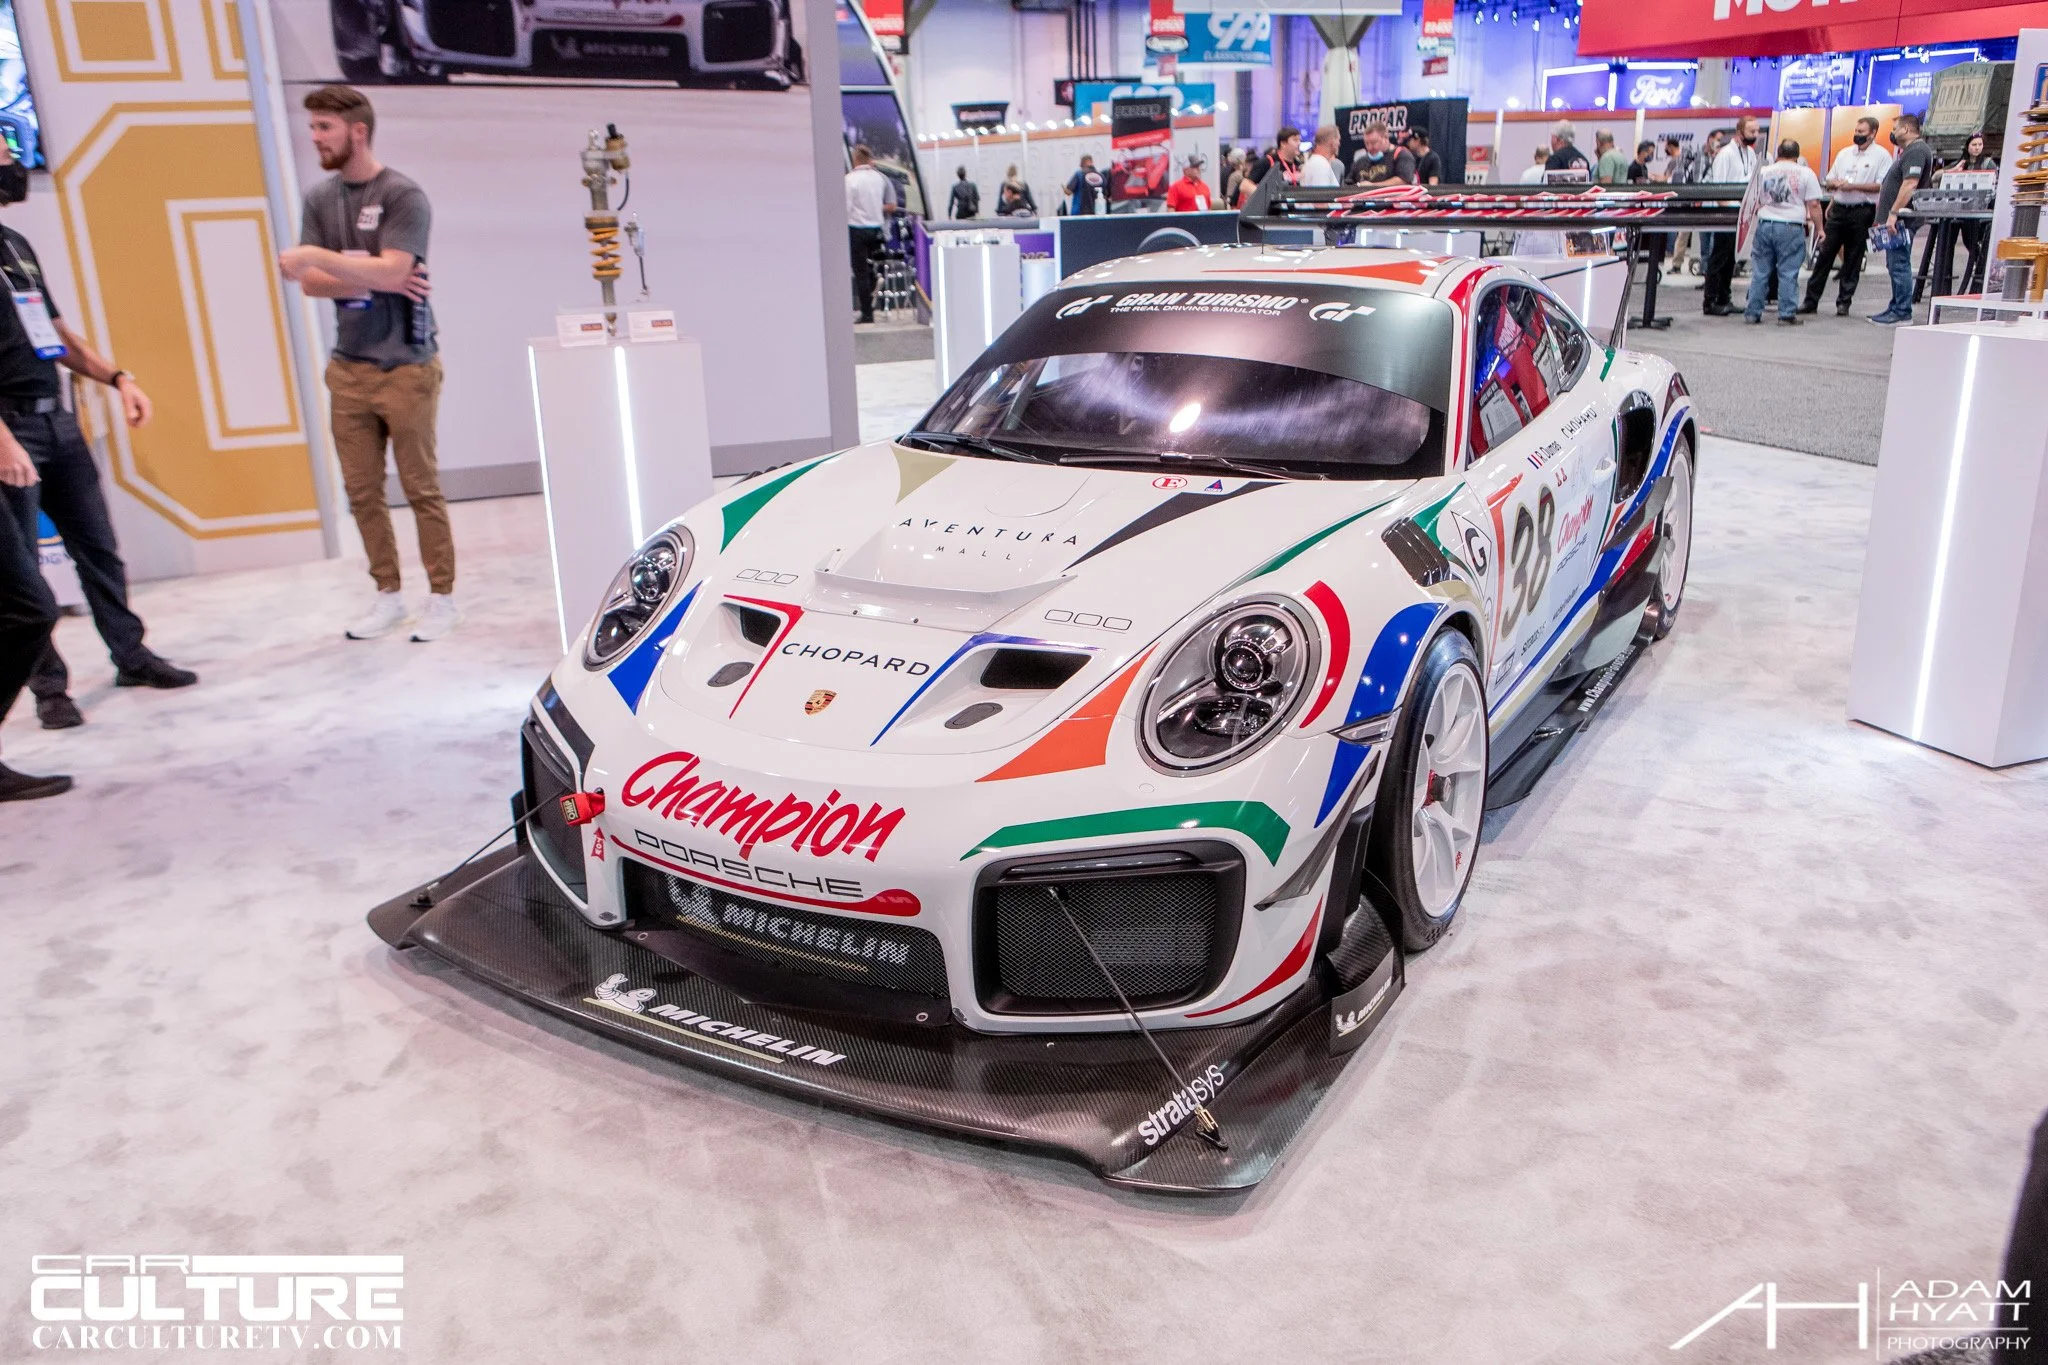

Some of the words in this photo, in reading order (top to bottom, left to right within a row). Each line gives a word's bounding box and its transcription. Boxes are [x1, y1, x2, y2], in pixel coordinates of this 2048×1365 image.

[1630, 75, 1684, 106] Ford
[1116, 293, 1188, 307] GRAN
[1211, 306, 1281, 316] SIMULATOR
[1561, 406, 1598, 440] CHOPARD
[899, 517, 1077, 546] AVENTURA
[1557, 494, 1594, 554] Champion
[935, 545, 1013, 561] MALL
[1502, 482, 1556, 642] 38
[781, 642, 930, 676] CHOPARD
[621, 751, 906, 863] Champion
[634, 829, 864, 898] PORSCHE
[722, 902, 911, 966] MICHELIN
[648, 1003, 848, 1066] MICHELIN
[1137, 1063, 1225, 1146] stratasys
